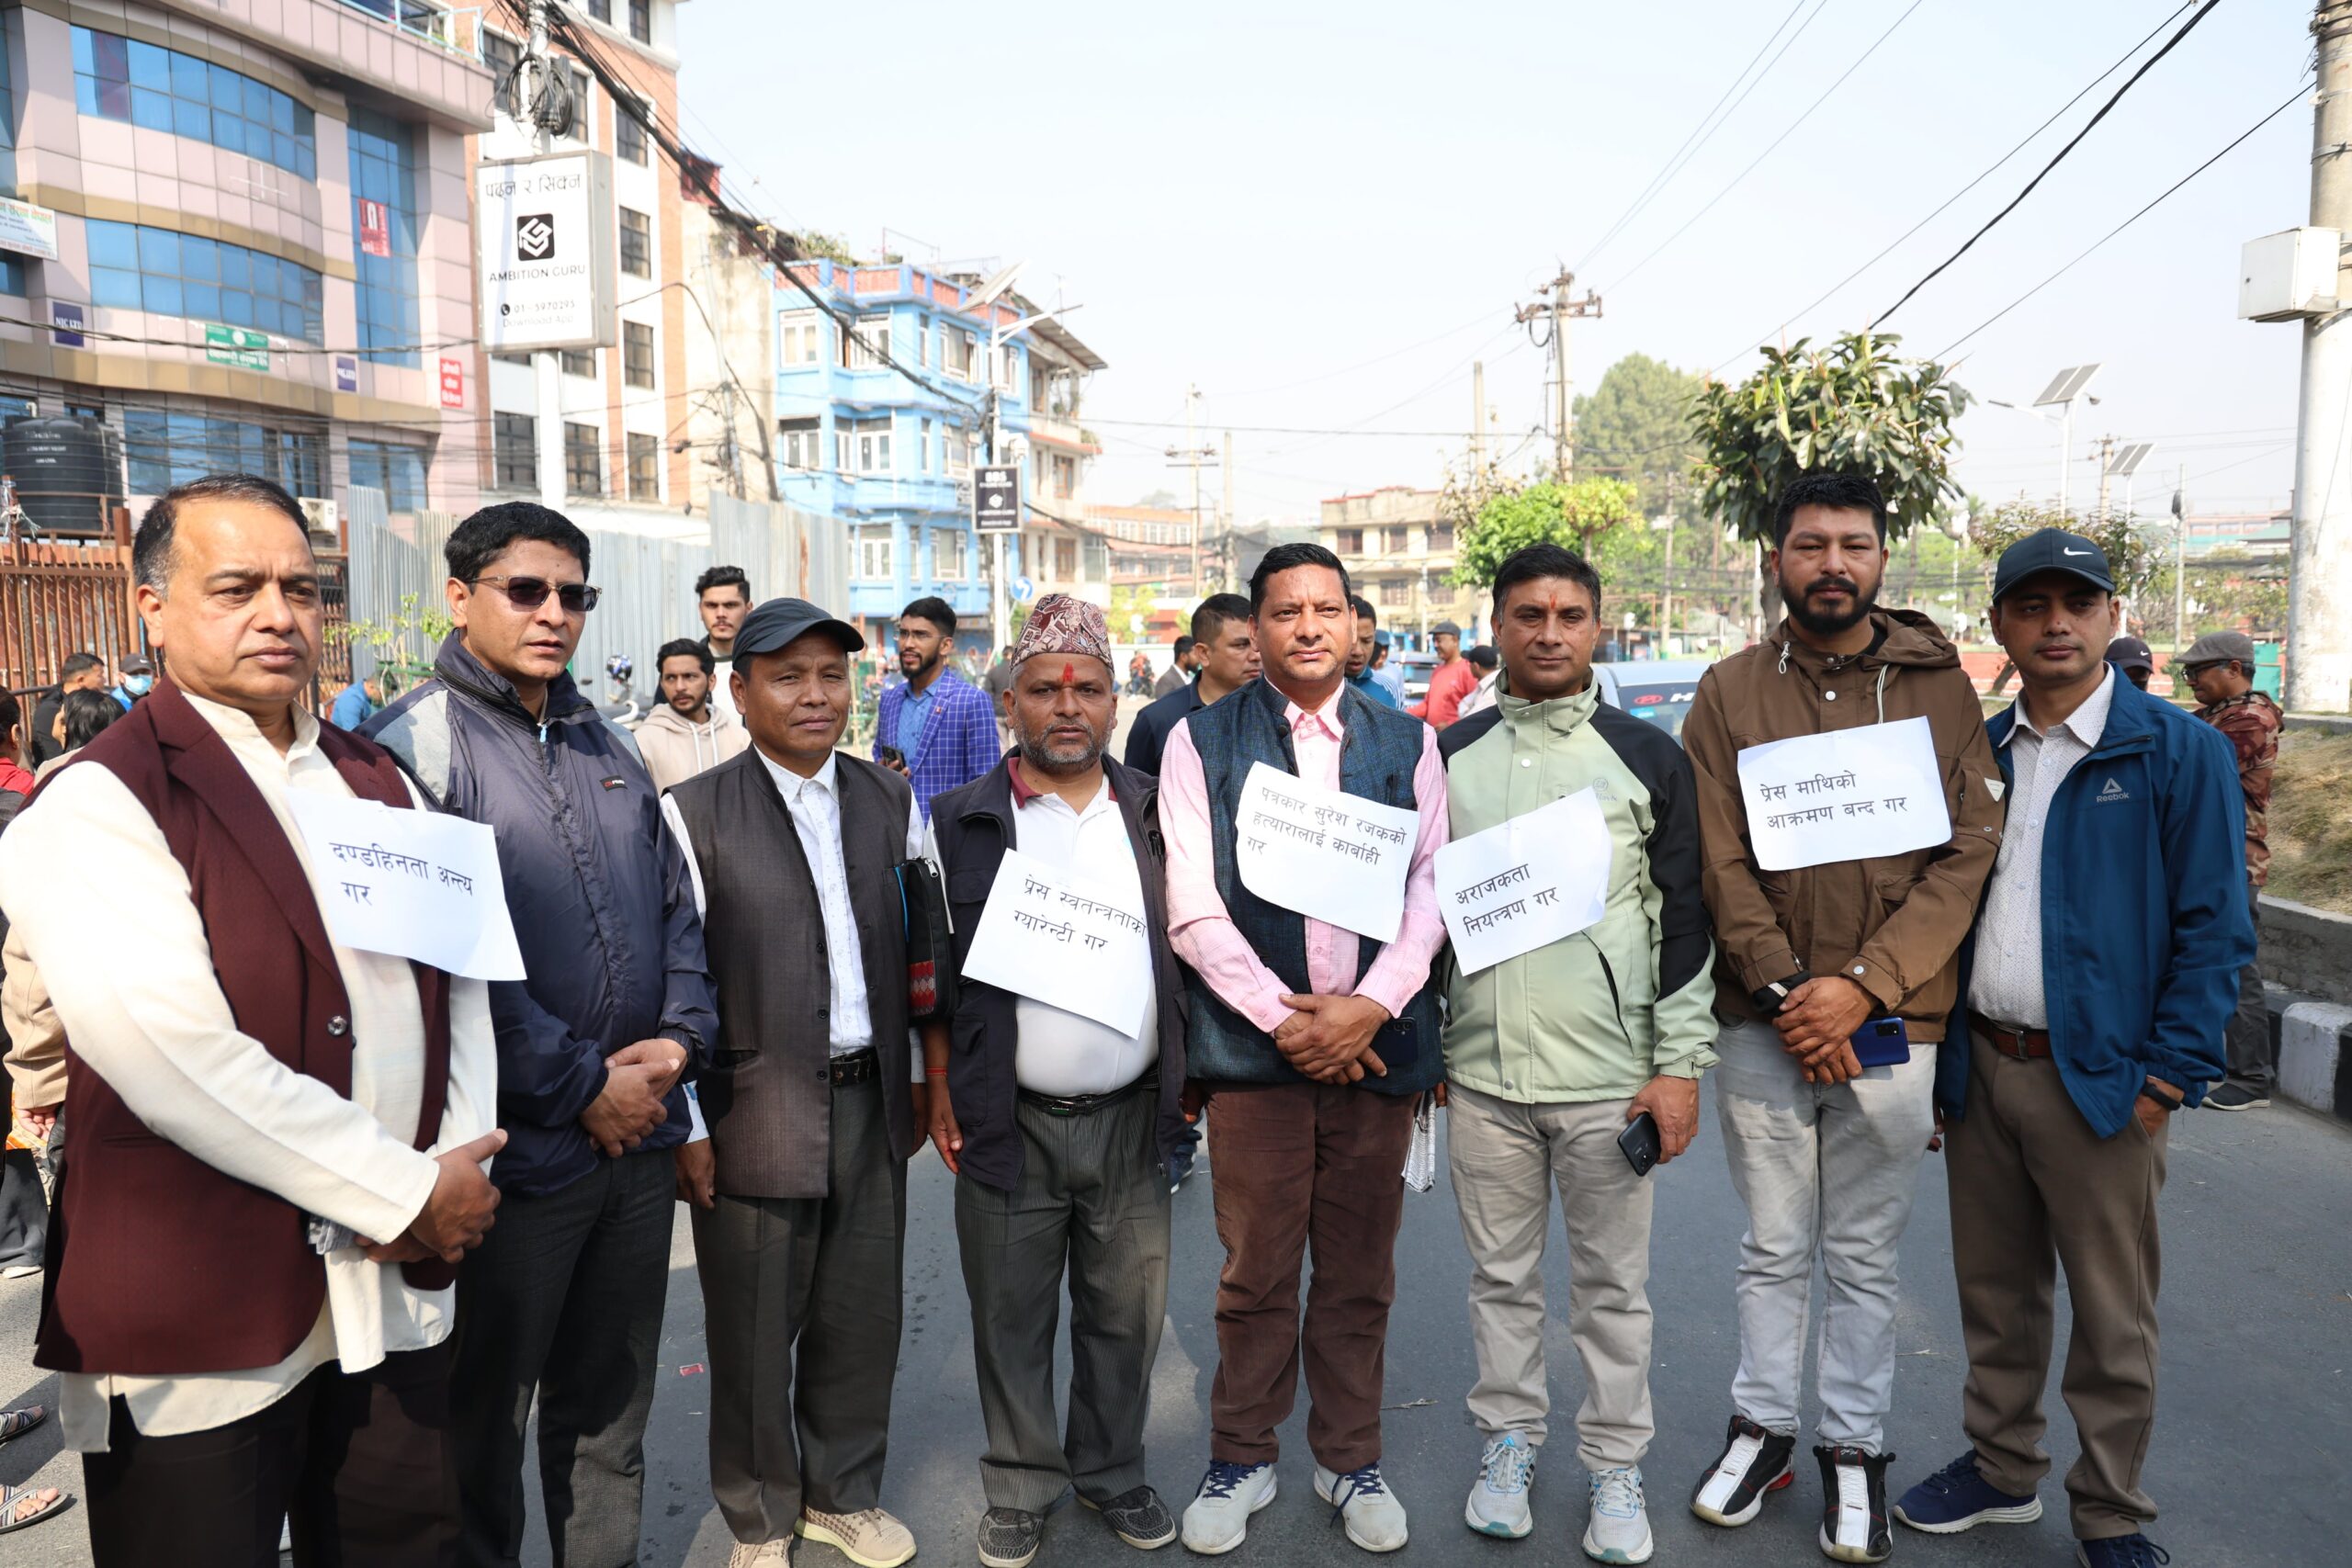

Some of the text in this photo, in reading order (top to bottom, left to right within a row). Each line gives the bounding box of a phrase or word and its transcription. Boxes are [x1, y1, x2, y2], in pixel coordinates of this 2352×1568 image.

[489, 265, 586, 283] AMBITION GURU
[1759, 770, 1857, 803] प्रेस माथिको
[2096, 792, 2130, 803] Reebok
[1253, 811, 1328, 849] हत्यारालाई
[1261, 786, 1408, 846] पत्रकार सुरेश रजकको
[1767, 796, 1908, 829] आक्रमण बन्द गर
[328, 841, 429, 880] दण्डहिनता
[1248, 836, 1268, 855] गर
[341, 881, 373, 906] गर
[1454, 863, 1532, 905] अराजकता
[1023, 874, 1148, 938] प्रेस स्वतन्त्रताको
[1463, 886, 1561, 937] नियन्त्रण गर
[1013, 909, 1109, 954] ग्यारेन्टी गर
